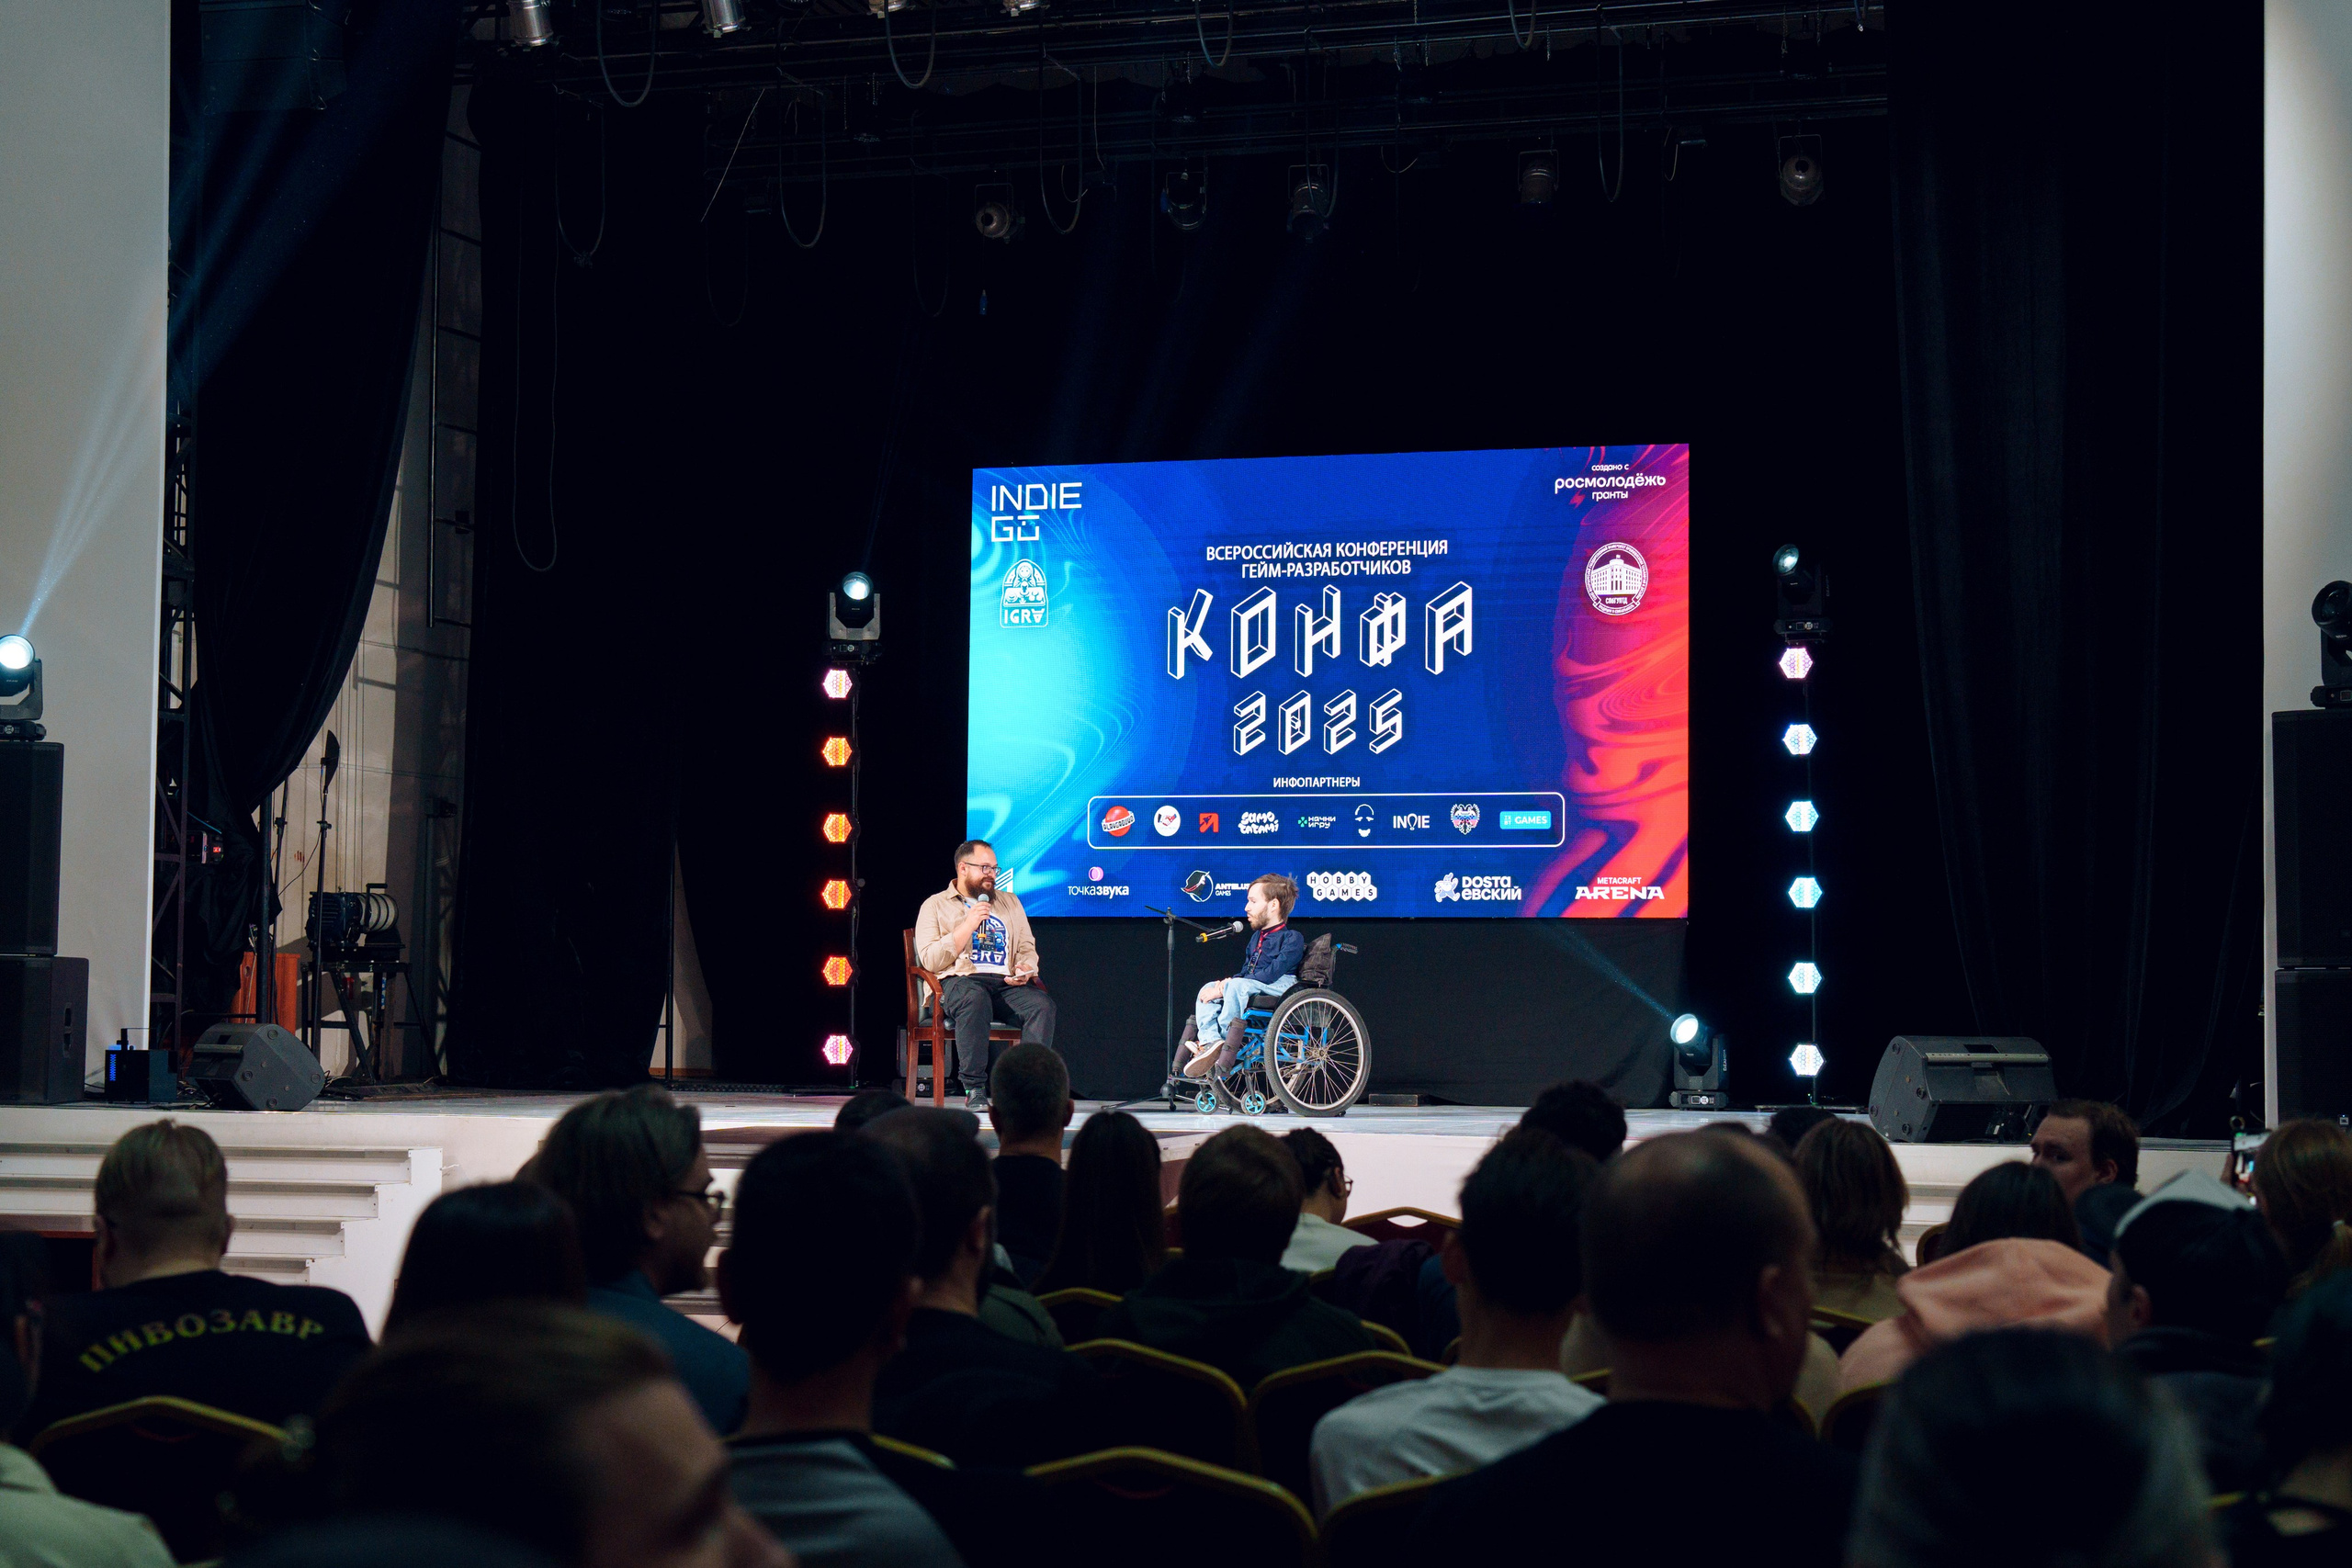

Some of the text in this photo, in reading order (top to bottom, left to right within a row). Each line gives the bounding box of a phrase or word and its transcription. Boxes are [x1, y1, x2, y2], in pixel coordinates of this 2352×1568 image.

[1555, 473, 1666, 494] росмолодёжь
[992, 482, 1081, 511] INDIE
[1591, 491, 1629, 502] гранты
[1206, 540, 1447, 561] ВСЕРОССИЙСКАЯ КОНФЕРЕНЦИЯ
[1242, 559, 1410, 578] ГЕЙМ-РАЗРАБОТЧИКОВ
[1168, 581, 1472, 679] КОНФА
[1234, 689, 1402, 755] 2025
[1273, 777, 1360, 787] ИНФОПАРТНЕРЫ
[1515, 816, 1548, 824] GAMES
[1309, 876, 1367, 885] HOBBY
[1597, 876, 1642, 886] METACRAFT
[1316, 888, 1374, 897] GAMES
[1461, 886, 1523, 901] евский
[1576, 886, 1665, 899] ARENA
[79, 1309, 323, 1372] ПИВОЗАВР
